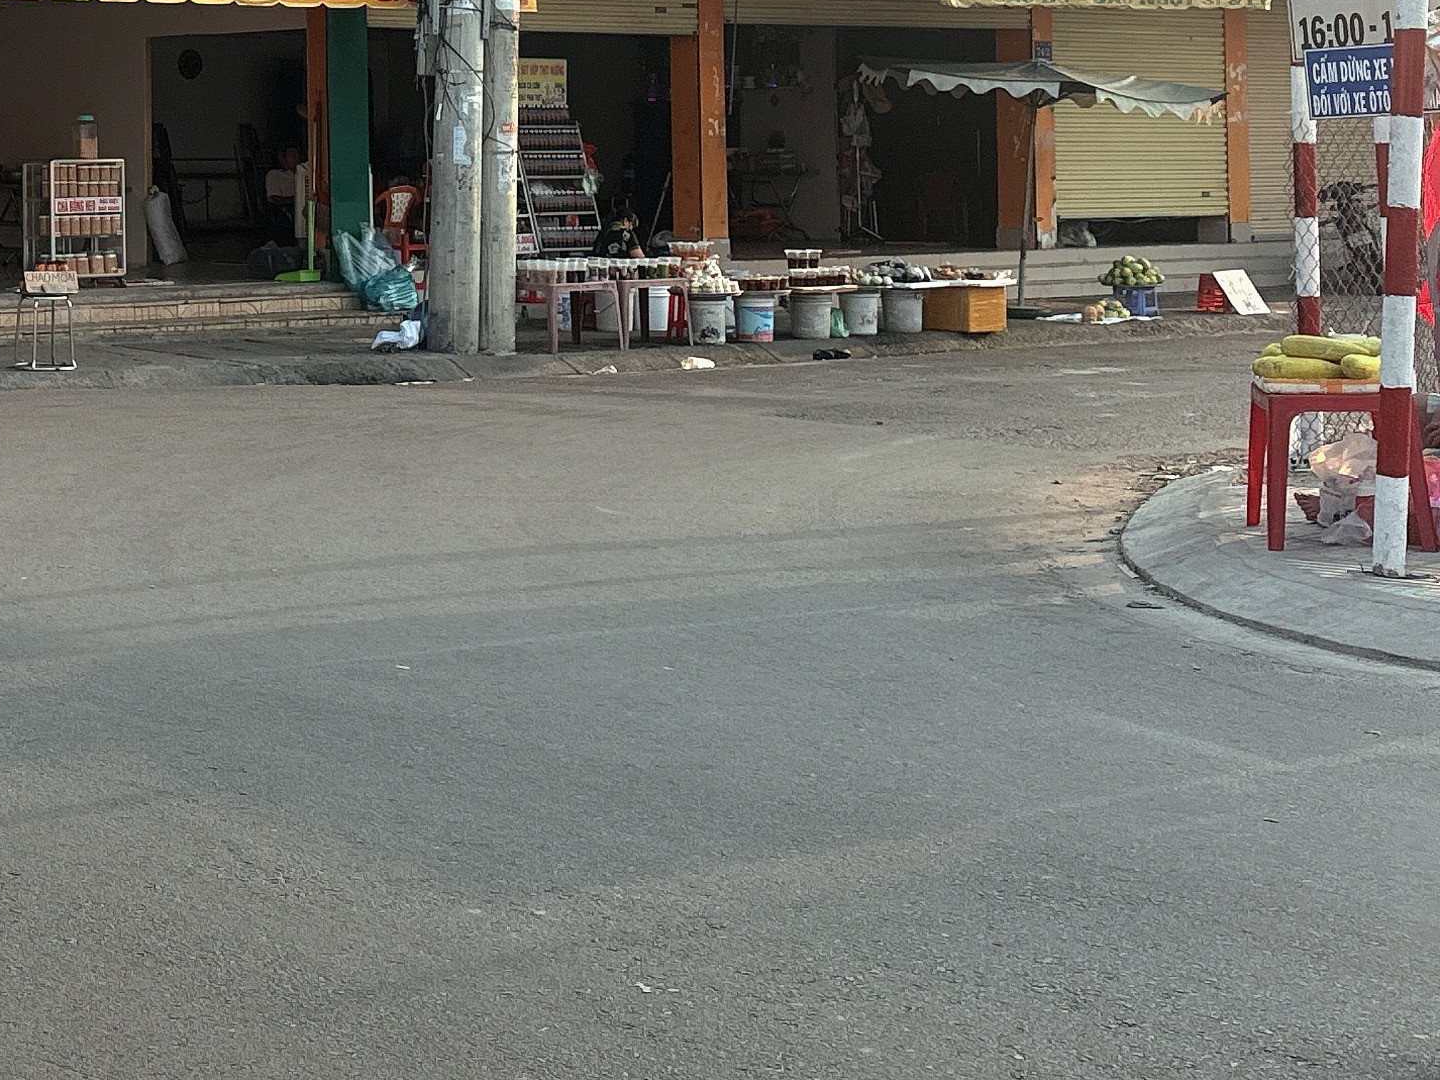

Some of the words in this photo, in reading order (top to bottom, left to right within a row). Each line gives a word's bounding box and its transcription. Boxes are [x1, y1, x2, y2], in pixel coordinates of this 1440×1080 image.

[1312, 54, 1339, 85] CẤM
[1339, 54, 1372, 84] DỪNG
[1374, 58, 1389, 81] XE
[1335, 88, 1352, 115] VỚI
[1353, 91, 1368, 113] XE
[1369, 84, 1392, 113] ÔTÔ
